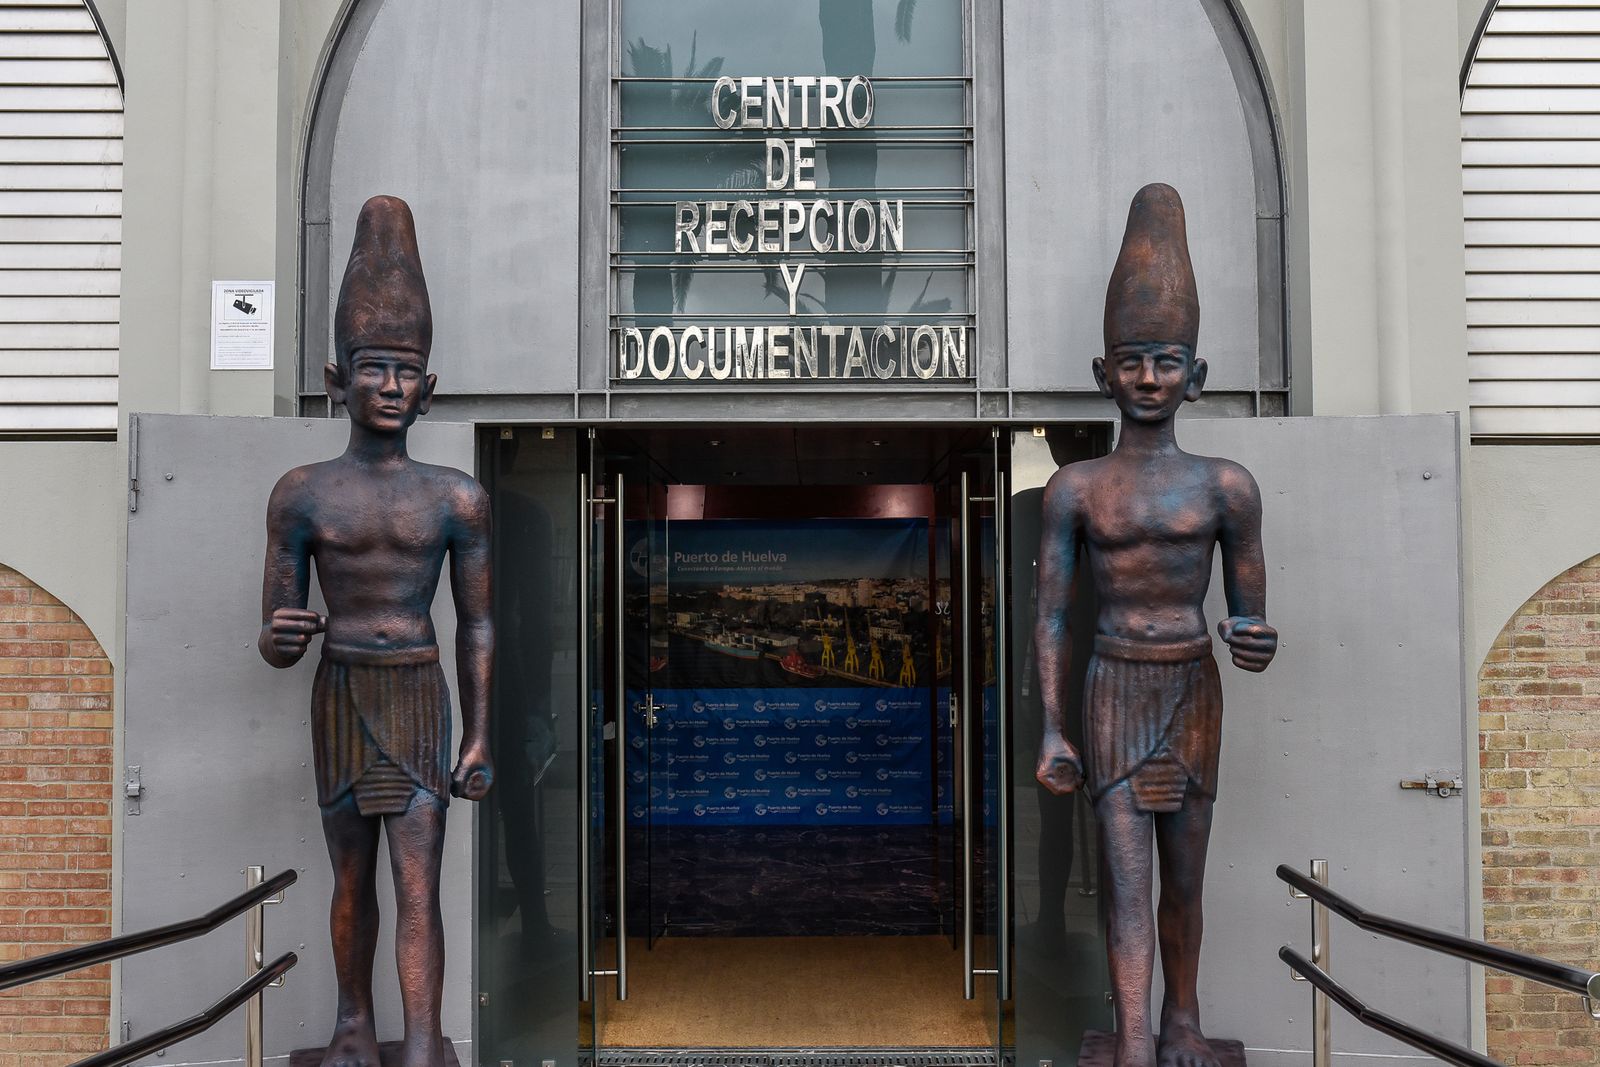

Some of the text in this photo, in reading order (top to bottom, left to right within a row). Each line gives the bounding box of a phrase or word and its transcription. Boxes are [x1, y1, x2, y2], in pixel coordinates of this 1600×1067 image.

[712, 75, 874, 129] CENTRO
[766, 138, 816, 190] DE
[675, 199, 904, 253] RECEPCION
[780, 263, 805, 316] Y
[620, 325, 966, 380] DOCUMENTACION
[674, 550, 787, 563] Puerto de Huelva
